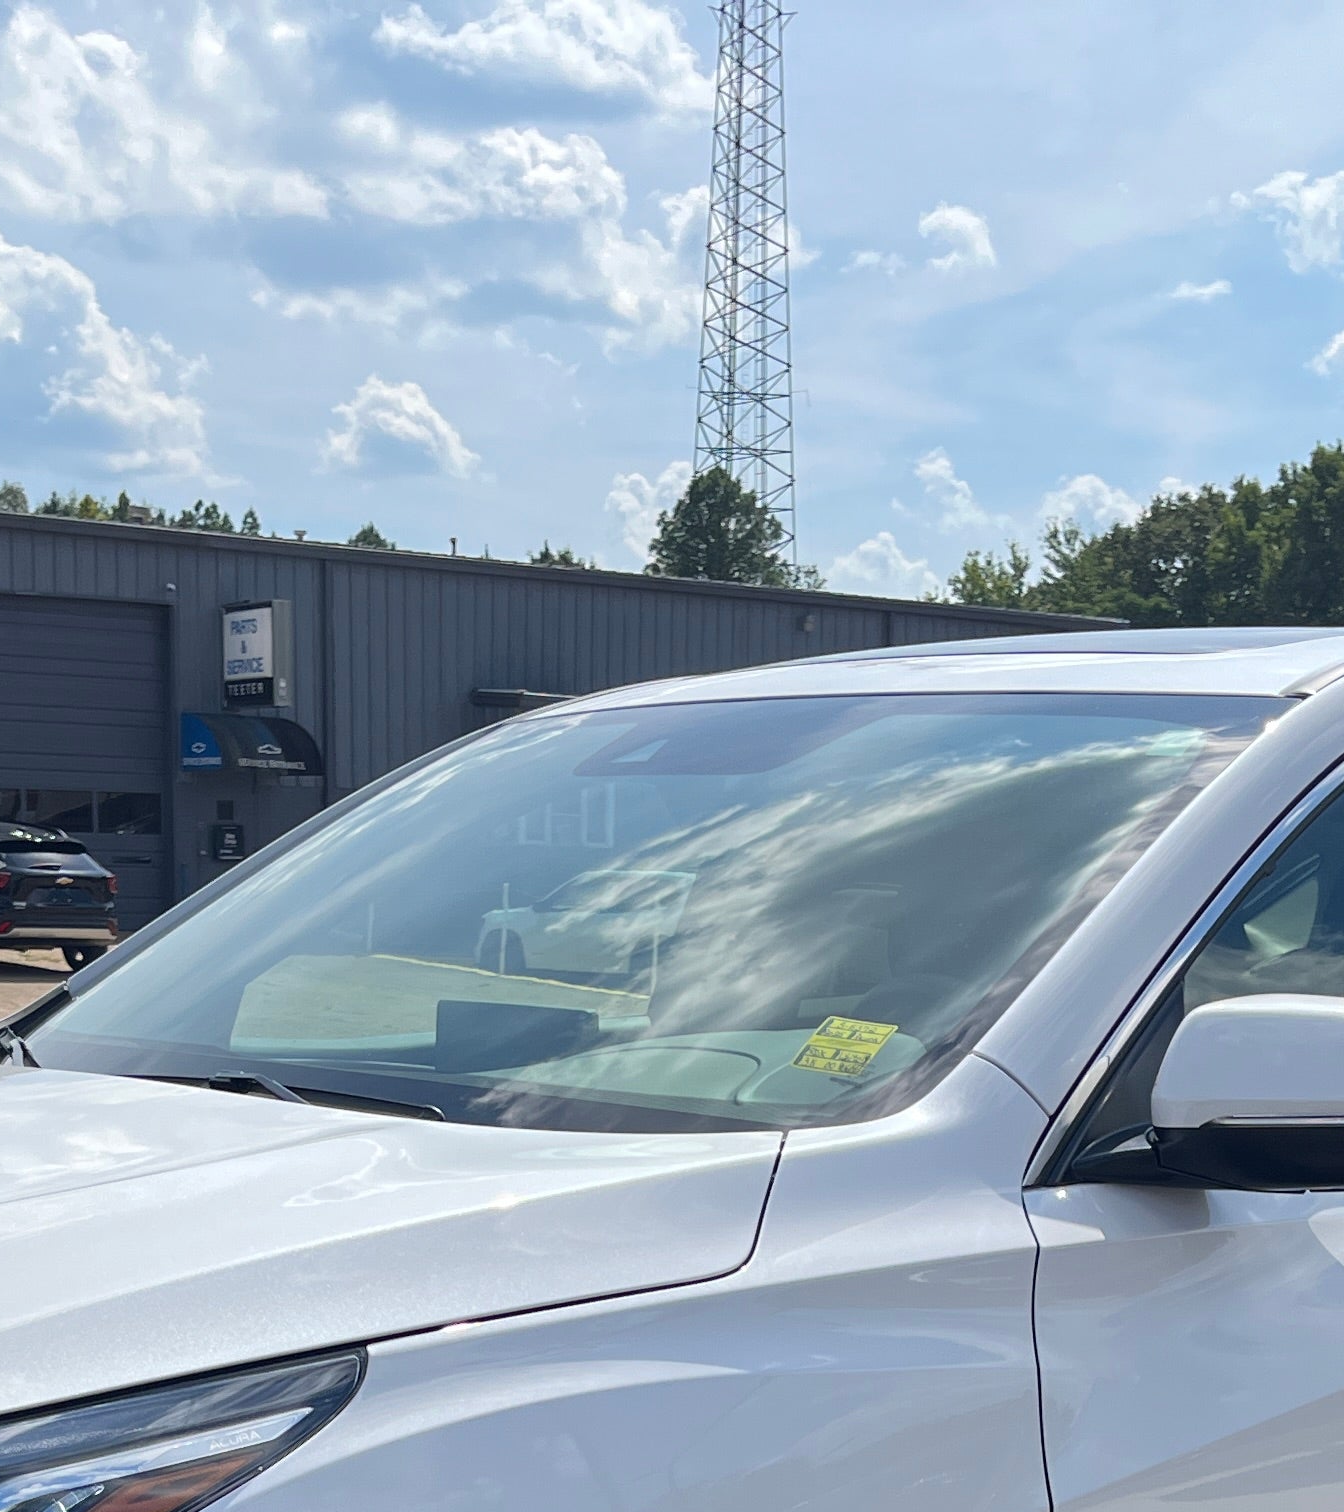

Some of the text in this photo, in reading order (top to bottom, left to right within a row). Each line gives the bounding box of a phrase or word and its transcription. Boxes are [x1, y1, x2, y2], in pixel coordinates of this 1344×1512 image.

[231, 619, 258, 635] PARTS
[227, 657, 264, 675] SERVICE
[228, 683, 264, 696] TEETER
[209, 1430, 262, 1451] ACURA
